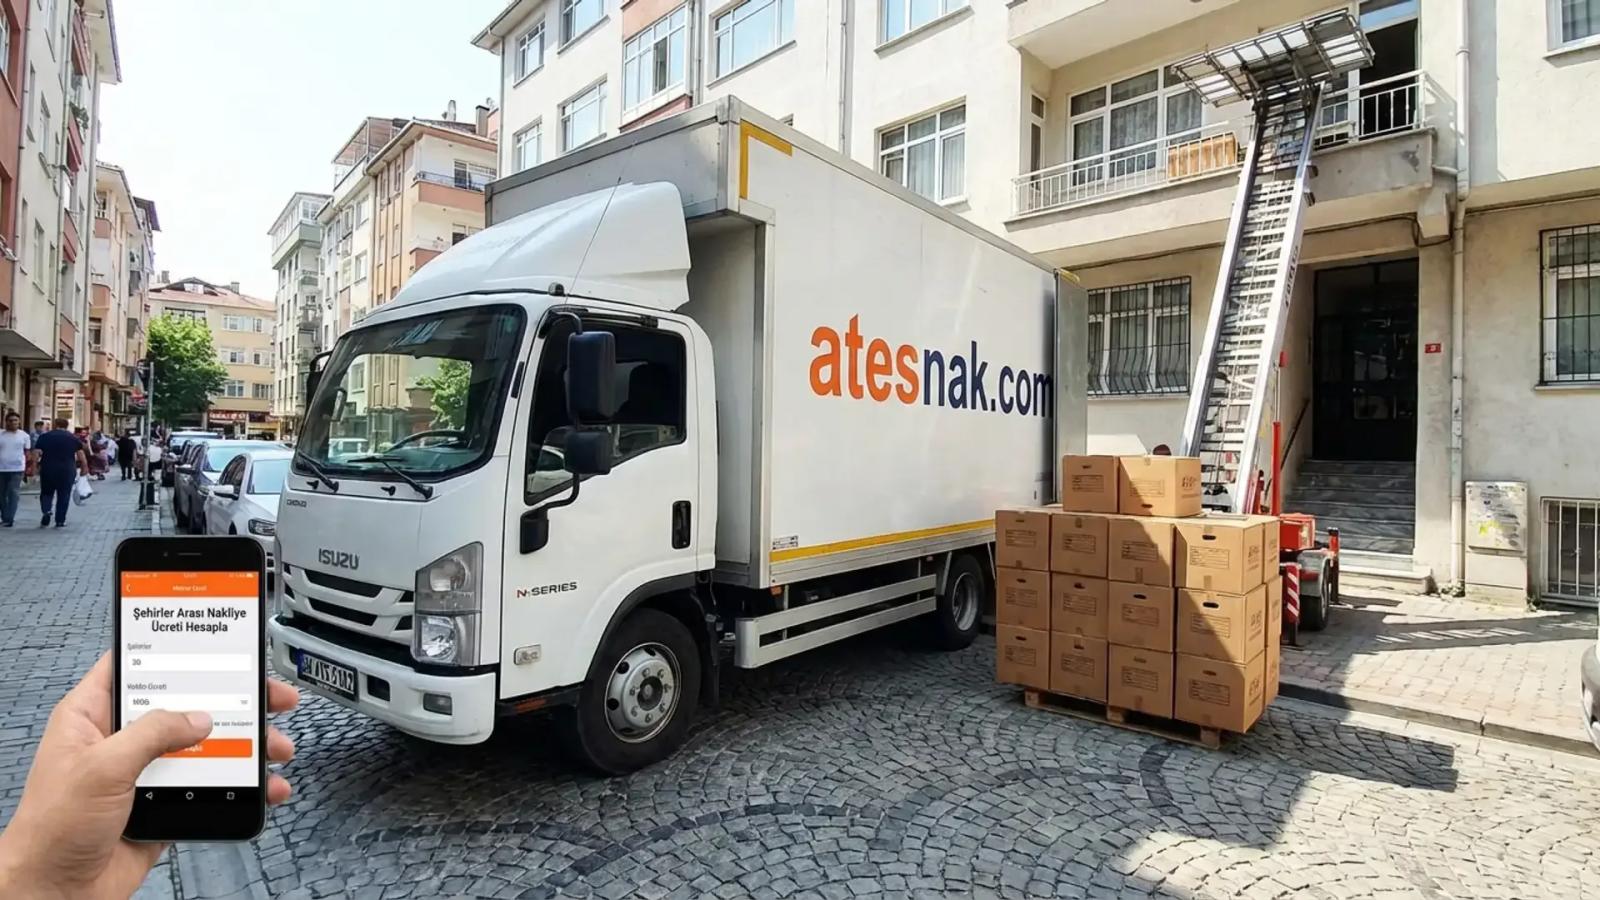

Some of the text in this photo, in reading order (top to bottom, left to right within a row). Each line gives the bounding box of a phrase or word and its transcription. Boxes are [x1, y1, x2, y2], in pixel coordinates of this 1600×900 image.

[809, 313, 1054, 418] atesnak.com
[318, 548, 359, 570] ISUZU
[133, 607, 247, 621] Şehirler Arası Nakliye
[151, 620, 228, 634] Ücreti Hesapla
